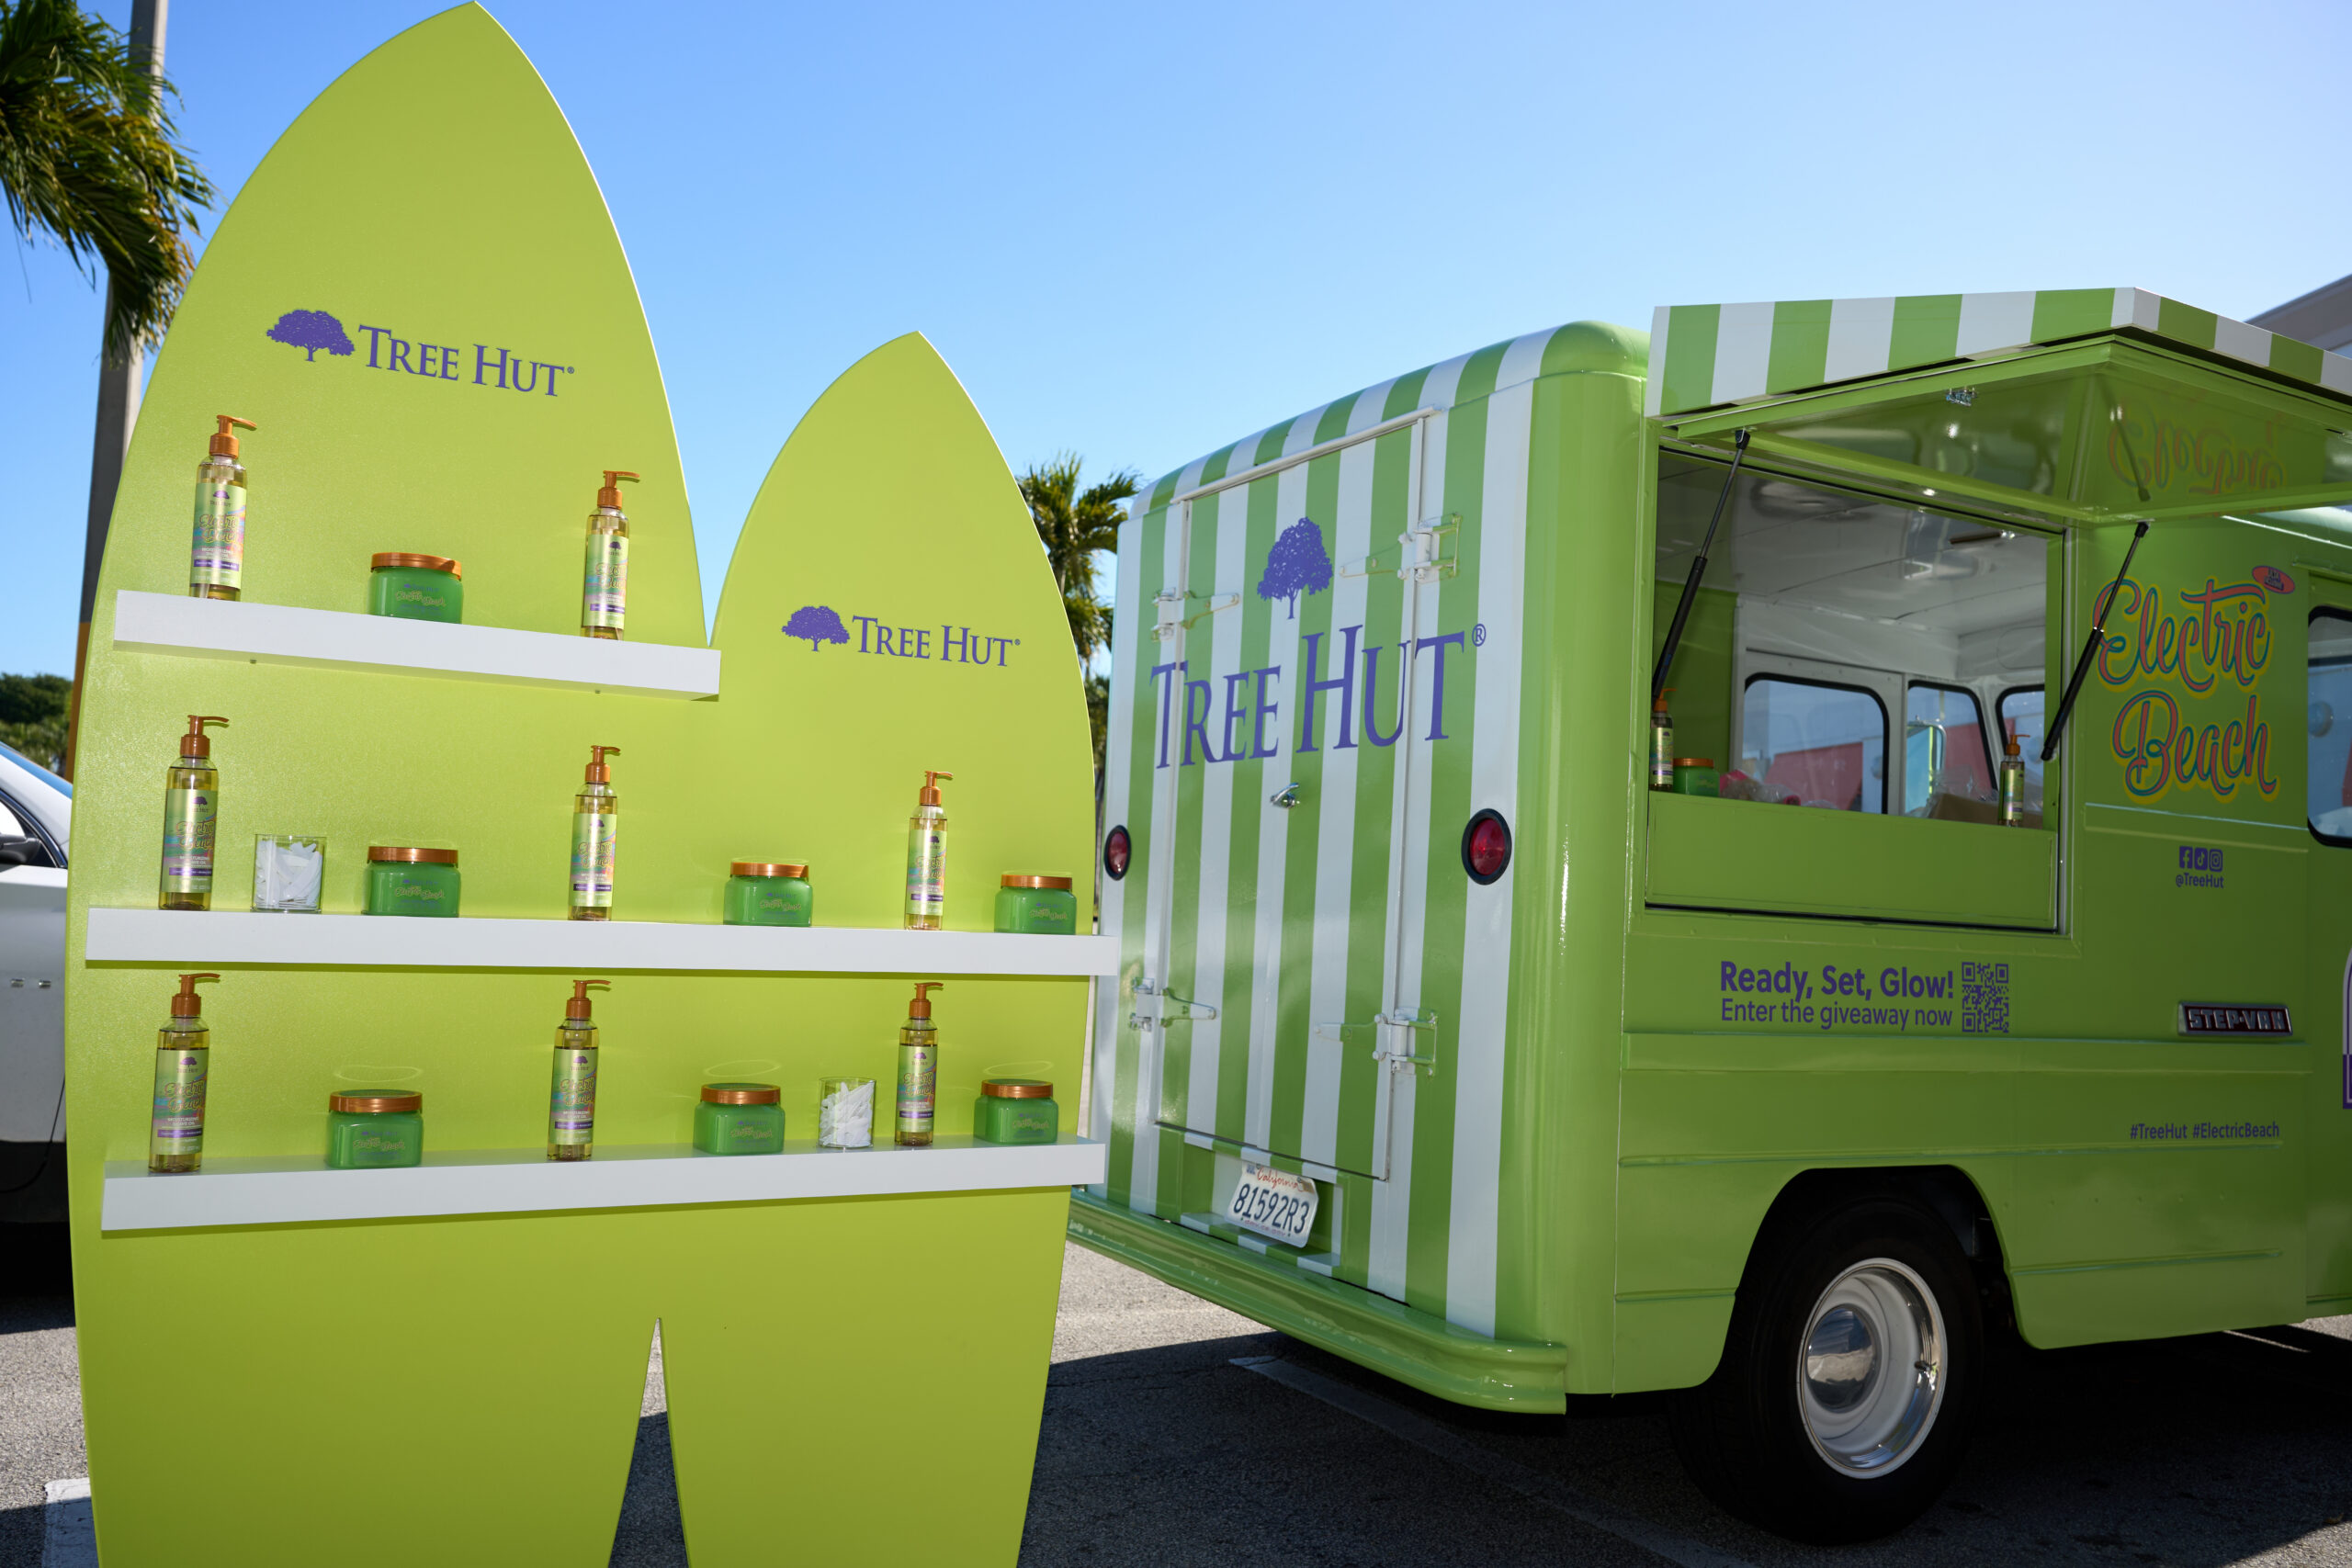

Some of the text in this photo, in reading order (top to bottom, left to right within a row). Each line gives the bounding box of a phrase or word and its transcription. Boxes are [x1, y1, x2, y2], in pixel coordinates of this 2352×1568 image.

[358, 324, 459, 381] TREE
[853, 615, 931, 659] TREE
[2091, 577, 2272, 694] Electric
[1150, 660, 1281, 769] TREE
[2112, 689, 2278, 797] Beach
[2176, 872, 2224, 889] @TreeHut
[1721, 961, 1953, 1002] Ready, Set, Glow!
[1722, 998, 1953, 1032] Enter the giveaway now
[2131, 1121, 2279, 1140] #TreeHut #ElectricBeach
[1233, 1183, 1310, 1235] 81592R3
